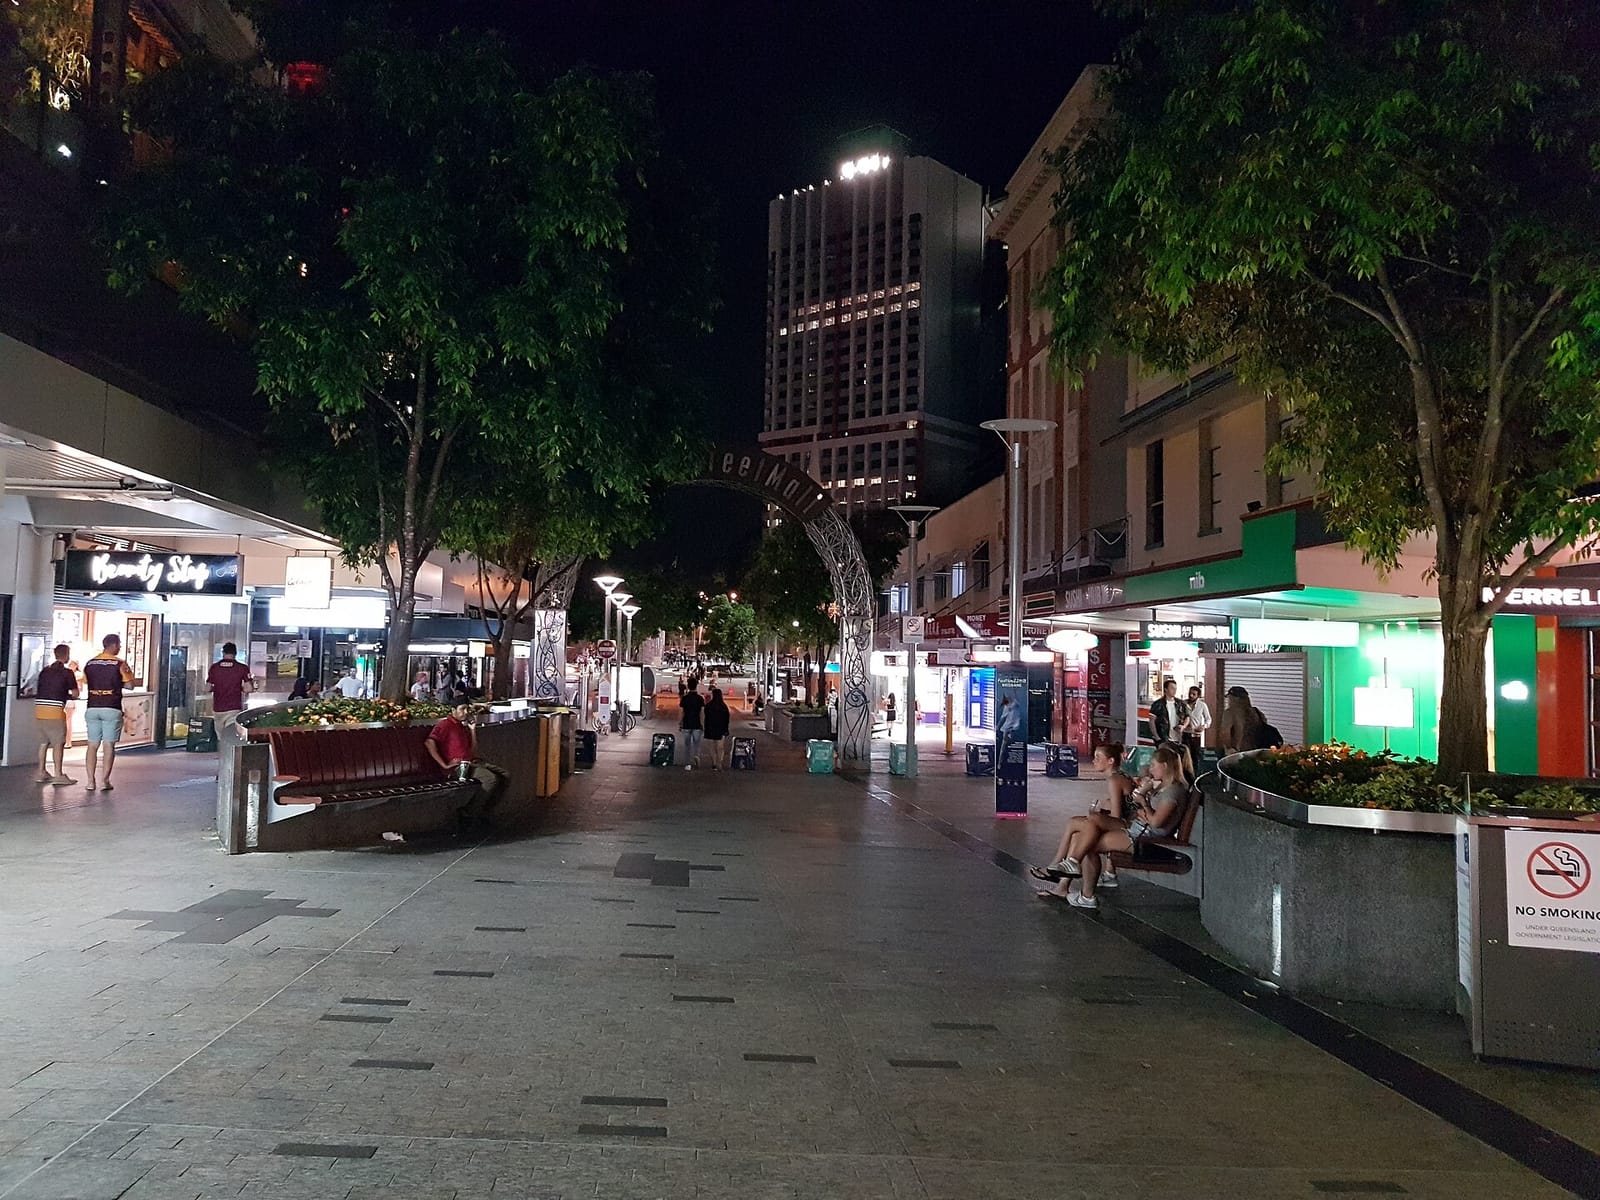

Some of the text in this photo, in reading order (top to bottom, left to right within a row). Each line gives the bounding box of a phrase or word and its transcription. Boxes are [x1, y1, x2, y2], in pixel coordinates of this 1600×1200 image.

[92, 553, 210, 591] Beauty Stop
[1189, 571, 1205, 589] nib
[1482, 587, 1600, 605] MERREL
[966, 614, 986, 622] MONEY
[1515, 906, 1536, 916] NO
[1550, 926, 1596, 934] QUEENSLAND
[1515, 931, 1561, 940] GOVERNMENT
